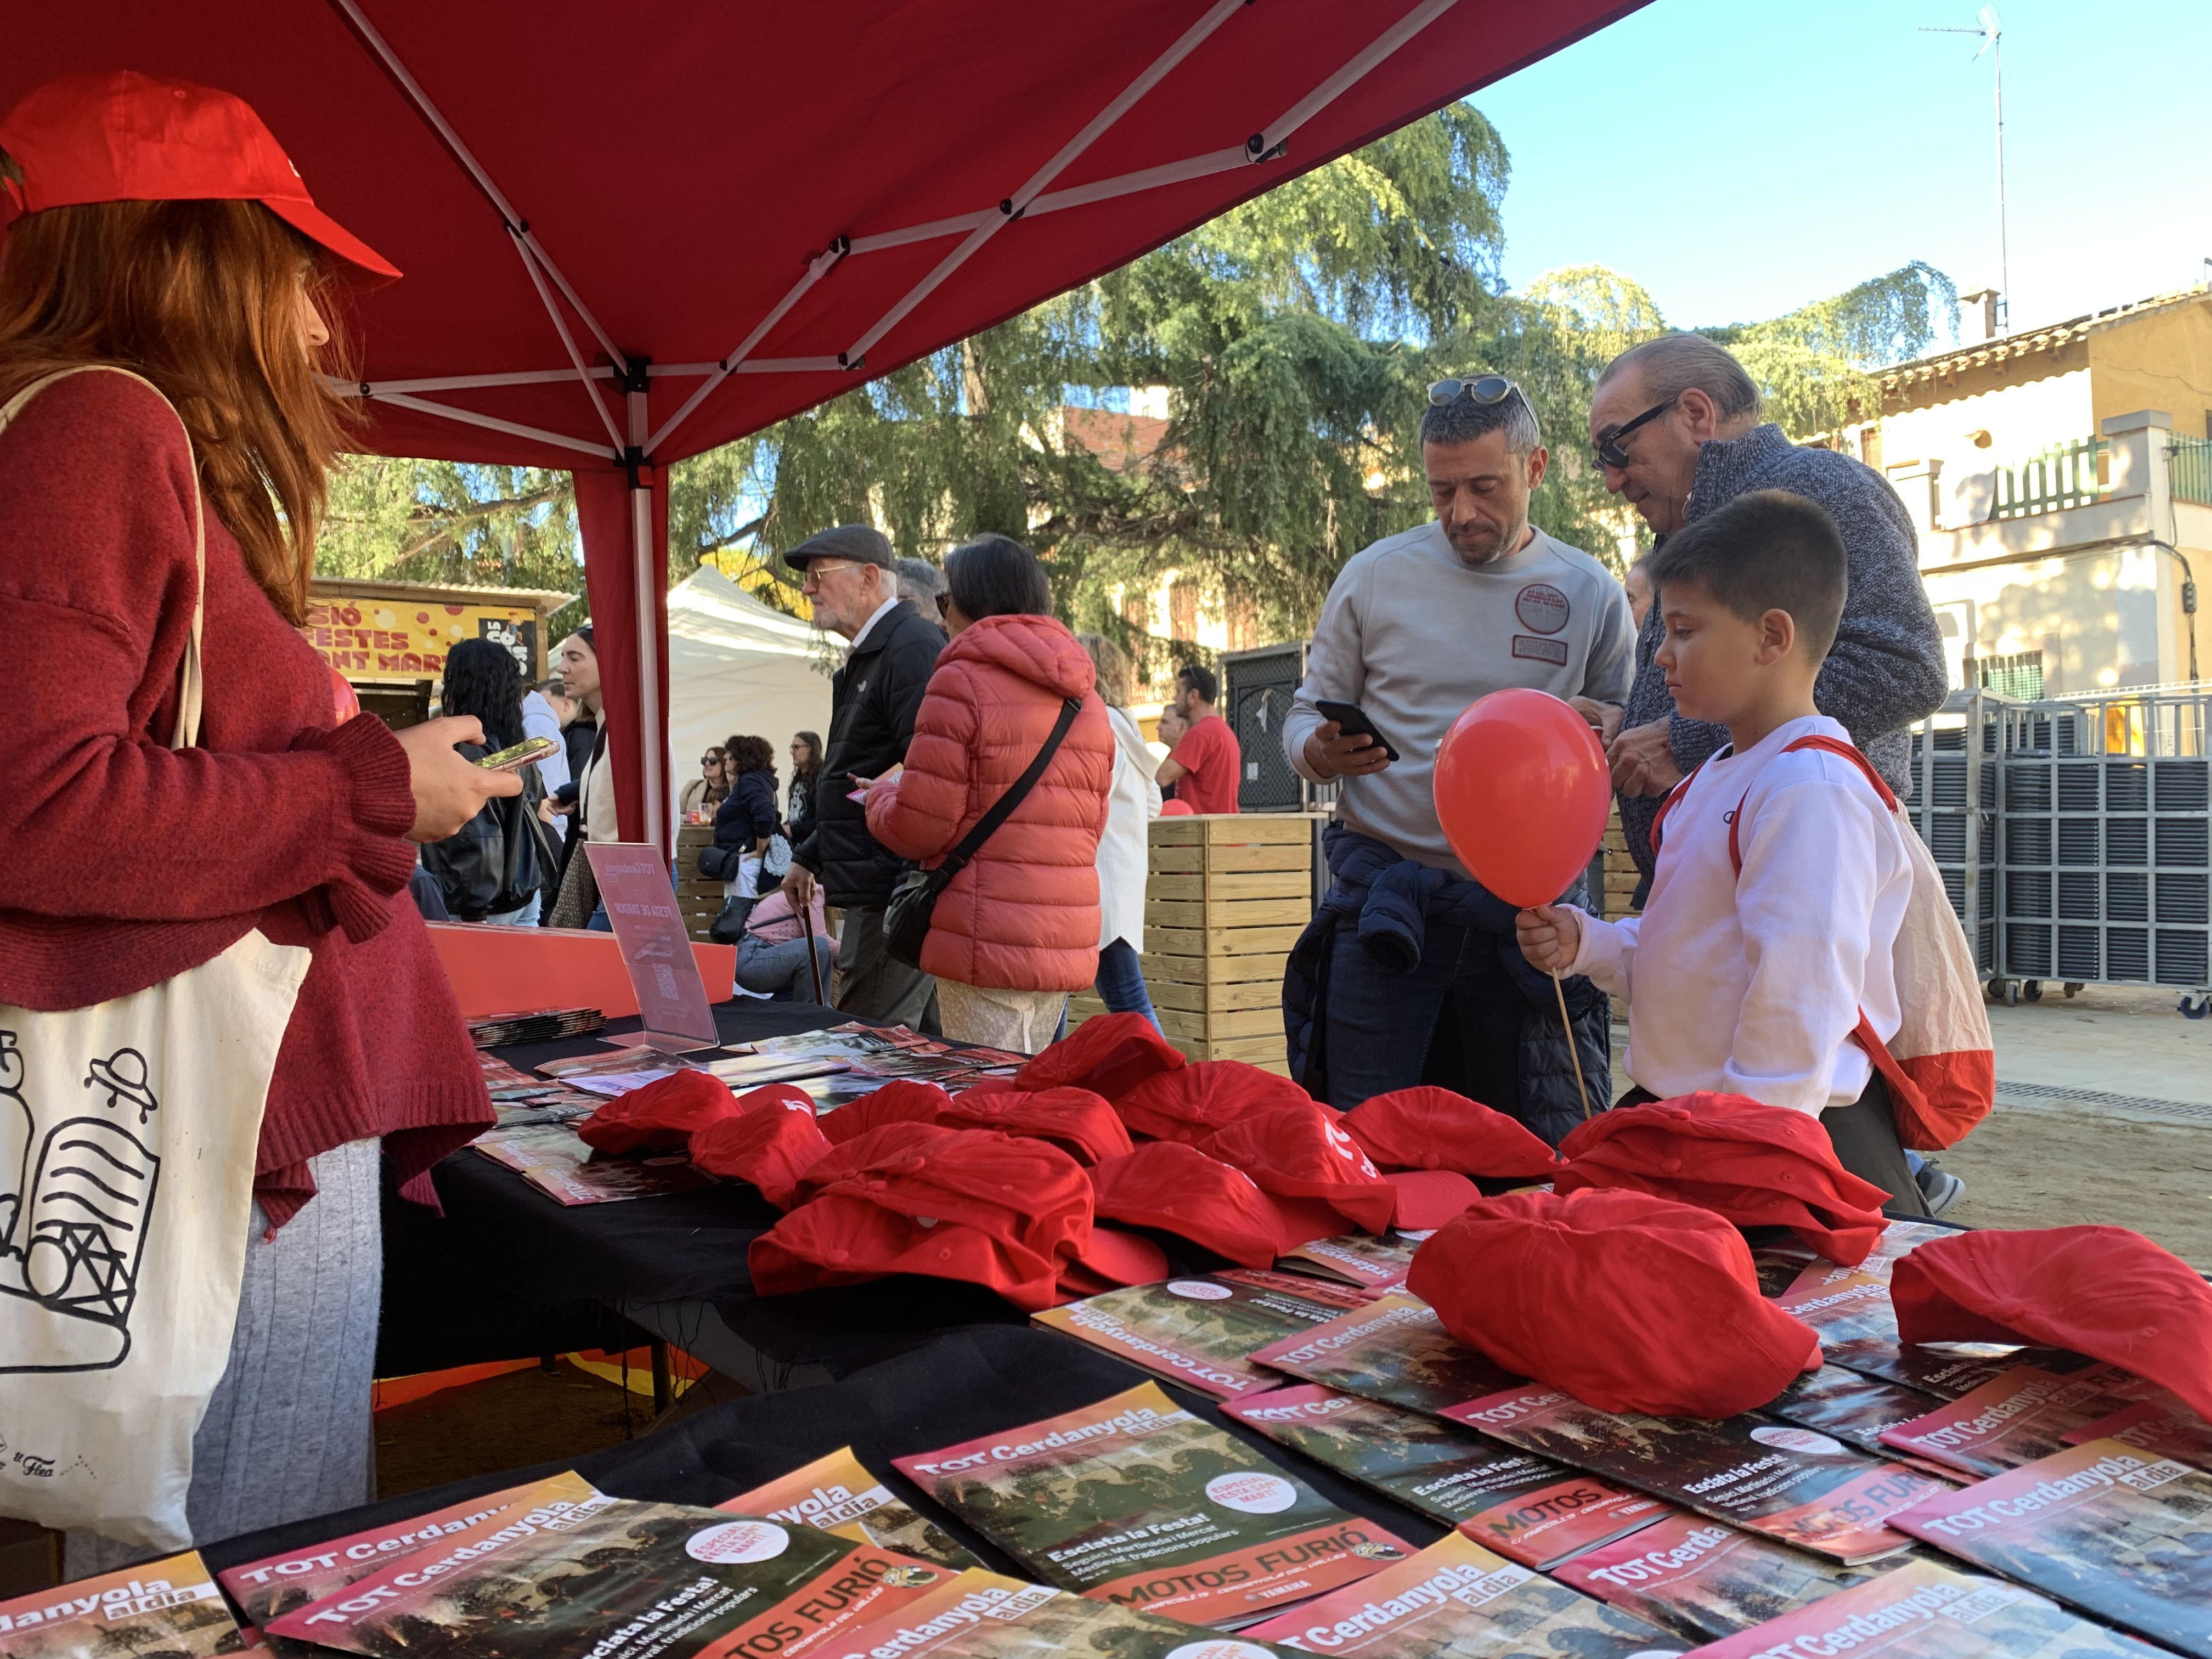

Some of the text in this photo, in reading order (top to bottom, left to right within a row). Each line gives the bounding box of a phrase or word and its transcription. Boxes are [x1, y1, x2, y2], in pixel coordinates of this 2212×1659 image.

[378, 652, 447, 672] MAR
[1069, 1313, 1196, 1369] Cerdanyola
[1273, 1307, 1419, 1364] TOT Cerdanyola
[1242, 1406, 1307, 1421] TOT
[1466, 1401, 1529, 1424] TOT
[1910, 1426, 1973, 1449] TOT
[1953, 1379, 2060, 1436] Cerdanyola
[915, 1407, 1162, 1476] TOT Cerdanyola
[1412, 1472, 1478, 1497] Esclata
[1471, 1466, 1495, 1477] la
[1920, 1506, 2002, 1537] TOT
[1988, 1454, 2147, 1518] Cerdanyola
[1047, 1513, 1211, 1563] Esclata la Festa!
[1110, 1537, 1171, 1555] Martinada
[1175, 1524, 1219, 1541] Mercat
[1487, 1488, 1602, 1539] MOTOS
[239, 1551, 339, 1584] TOT
[345, 1504, 510, 1561] Cerdan
[303, 1584, 402, 1627] TOT
[393, 1500, 577, 1587] Cerdanyola
[1107, 1526, 1370, 1606] MOTOS FURIÓ
[1129, 1541, 1189, 1561] tradicions
[1188, 1528, 1240, 1548] populars
[1587, 1558, 1663, 1586] TOT
[1645, 1524, 1736, 1569] Cerda
[635, 1609, 667, 1624] la
[655, 1576, 720, 1612] Festa!
[693, 1585, 735, 1612] Mercat
[713, 1587, 759, 1616] populars
[793, 1555, 894, 1624] FURIÓ
[1258, 1579, 1313, 1599] YAMAHA
[1305, 1563, 1487, 1647] Cerdanyola
[1794, 1582, 1967, 1656] Cerdanyola
